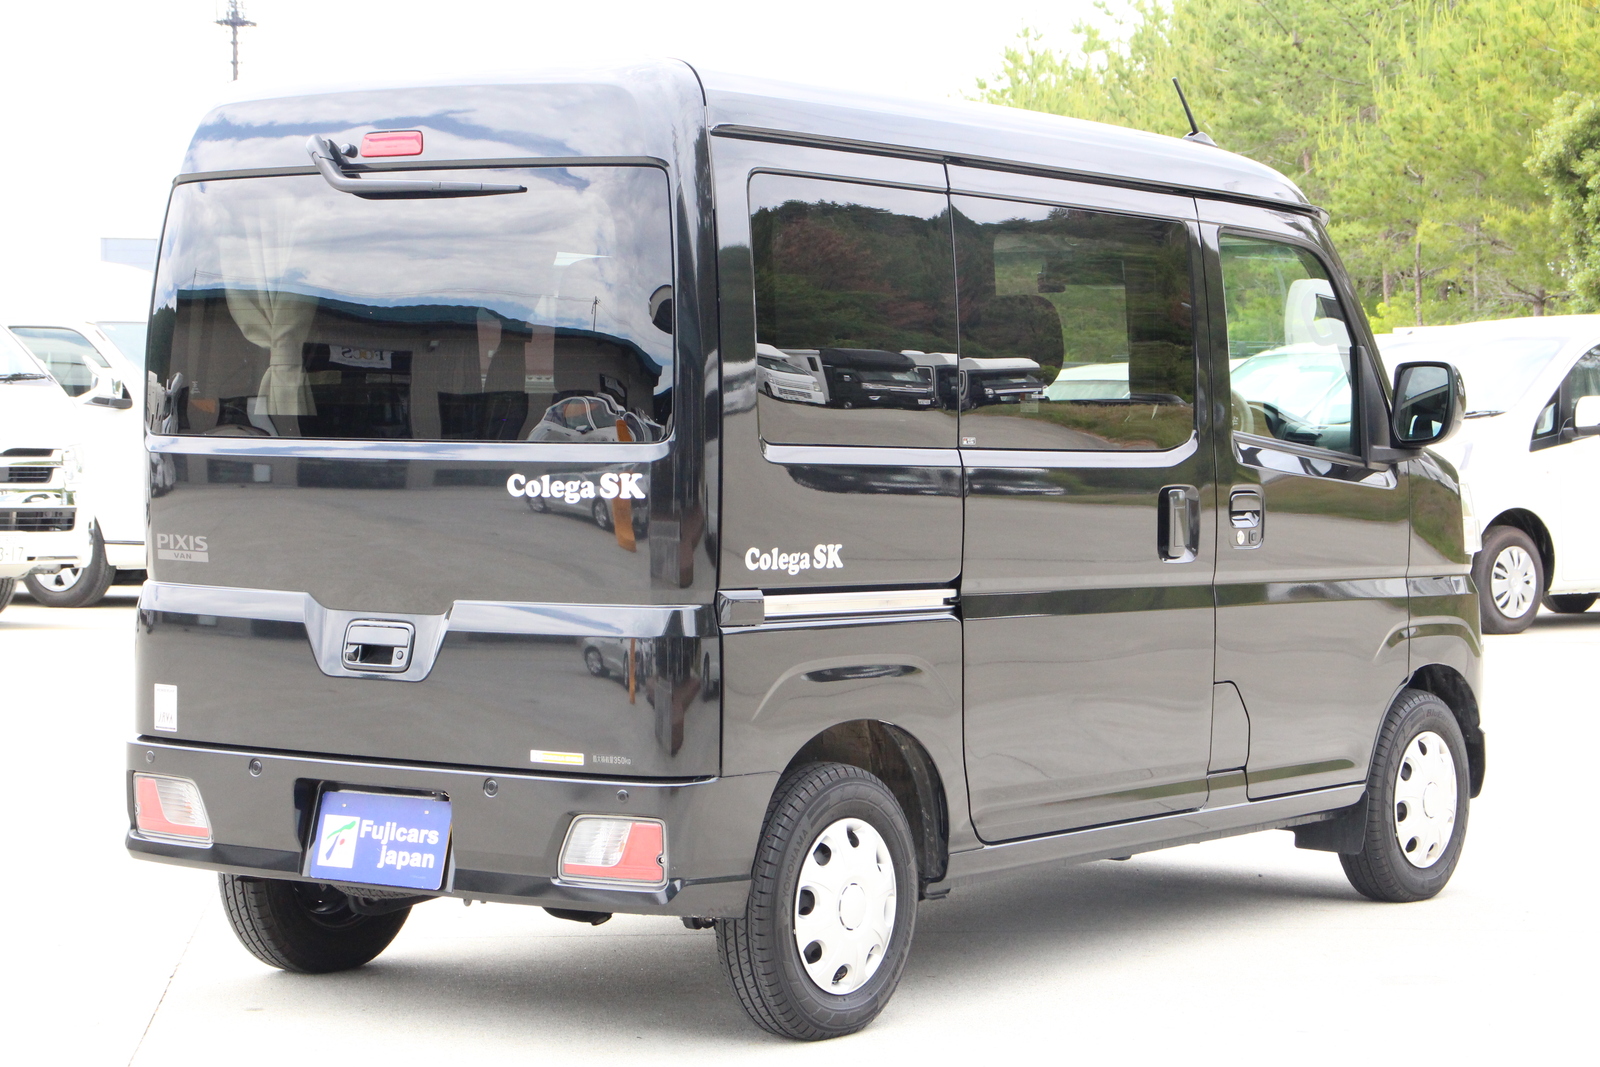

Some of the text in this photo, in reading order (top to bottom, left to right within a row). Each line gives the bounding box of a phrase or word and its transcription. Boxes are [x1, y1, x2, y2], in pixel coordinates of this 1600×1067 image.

[507, 472, 646, 504] Colega SK
[156, 533, 208, 551] PIXIS
[173, 552, 192, 560] VAN
[745, 544, 843, 575] Colega SK
[360, 819, 440, 845] Fujicars
[376, 845, 435, 870] japan
[781, 829, 808, 897] YOKOHAMA
